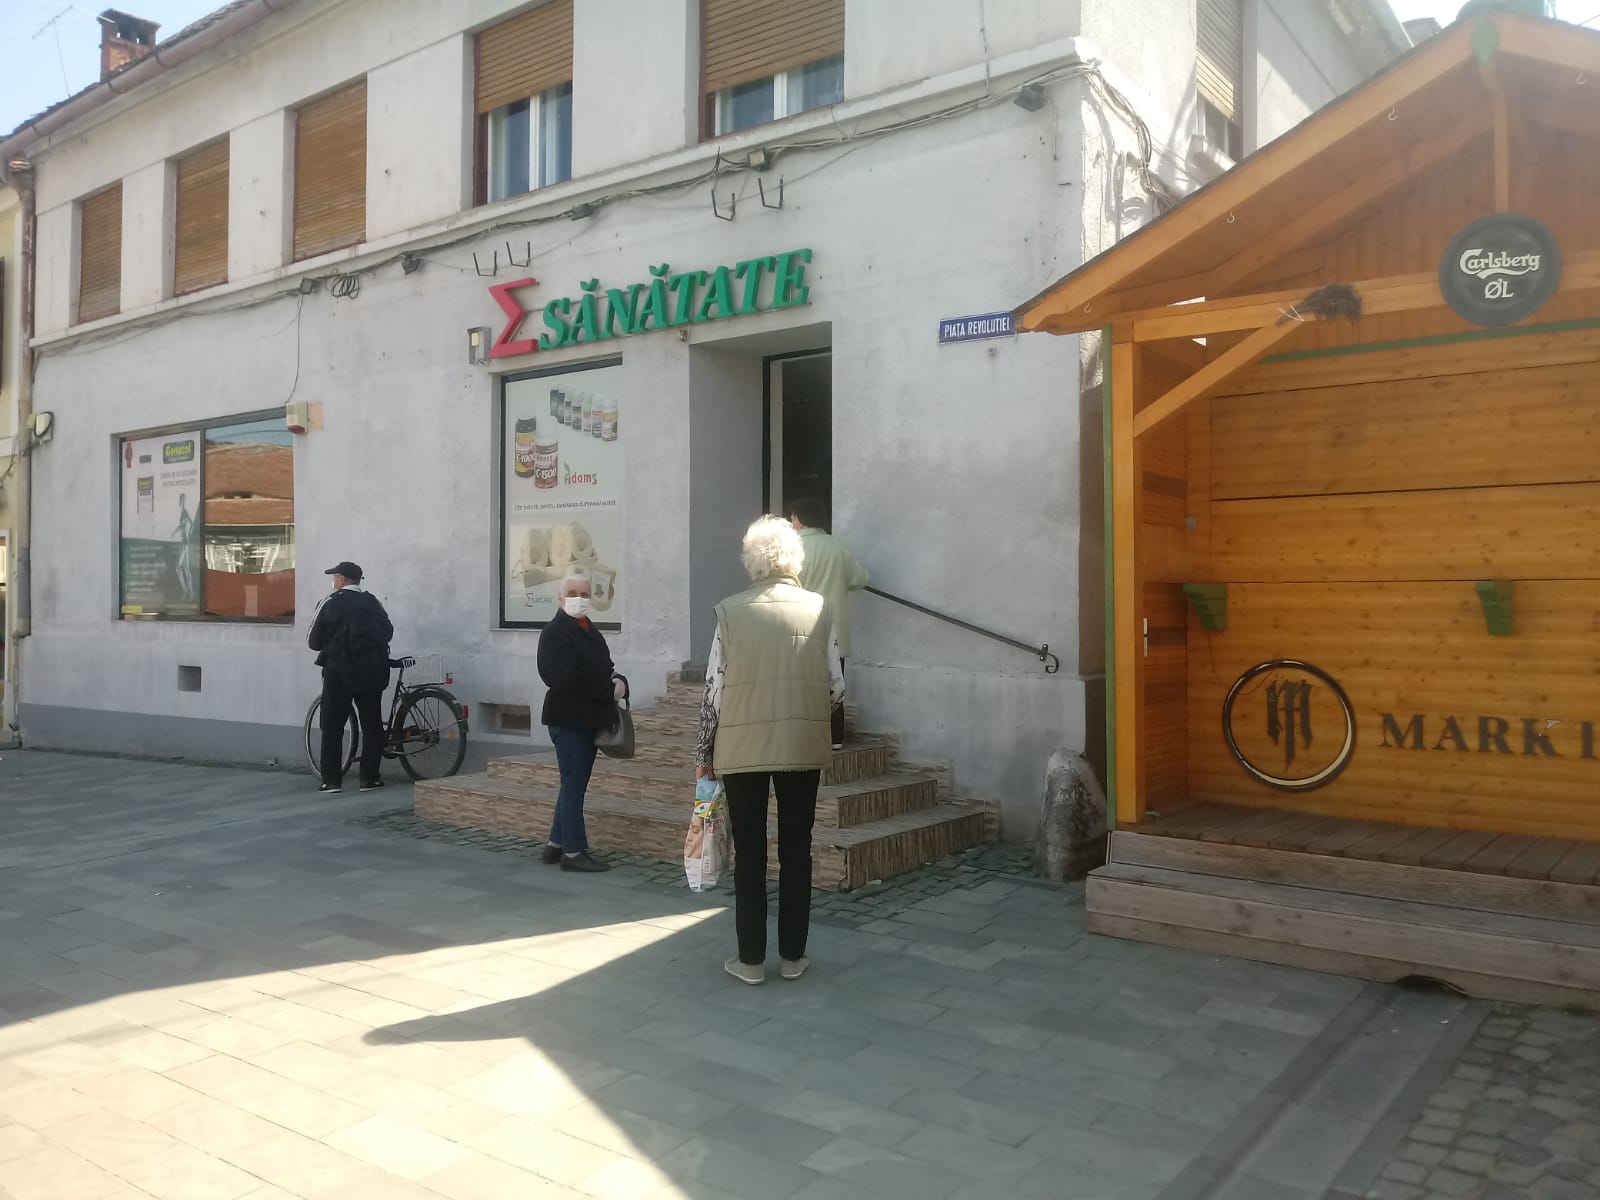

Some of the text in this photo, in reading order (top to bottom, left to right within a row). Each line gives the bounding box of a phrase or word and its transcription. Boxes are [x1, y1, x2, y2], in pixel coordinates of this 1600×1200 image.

[1460, 248, 1540, 277] Carlsberg
[539, 248, 813, 351] SĂNĂTATE
[564, 467, 598, 485] Adams
